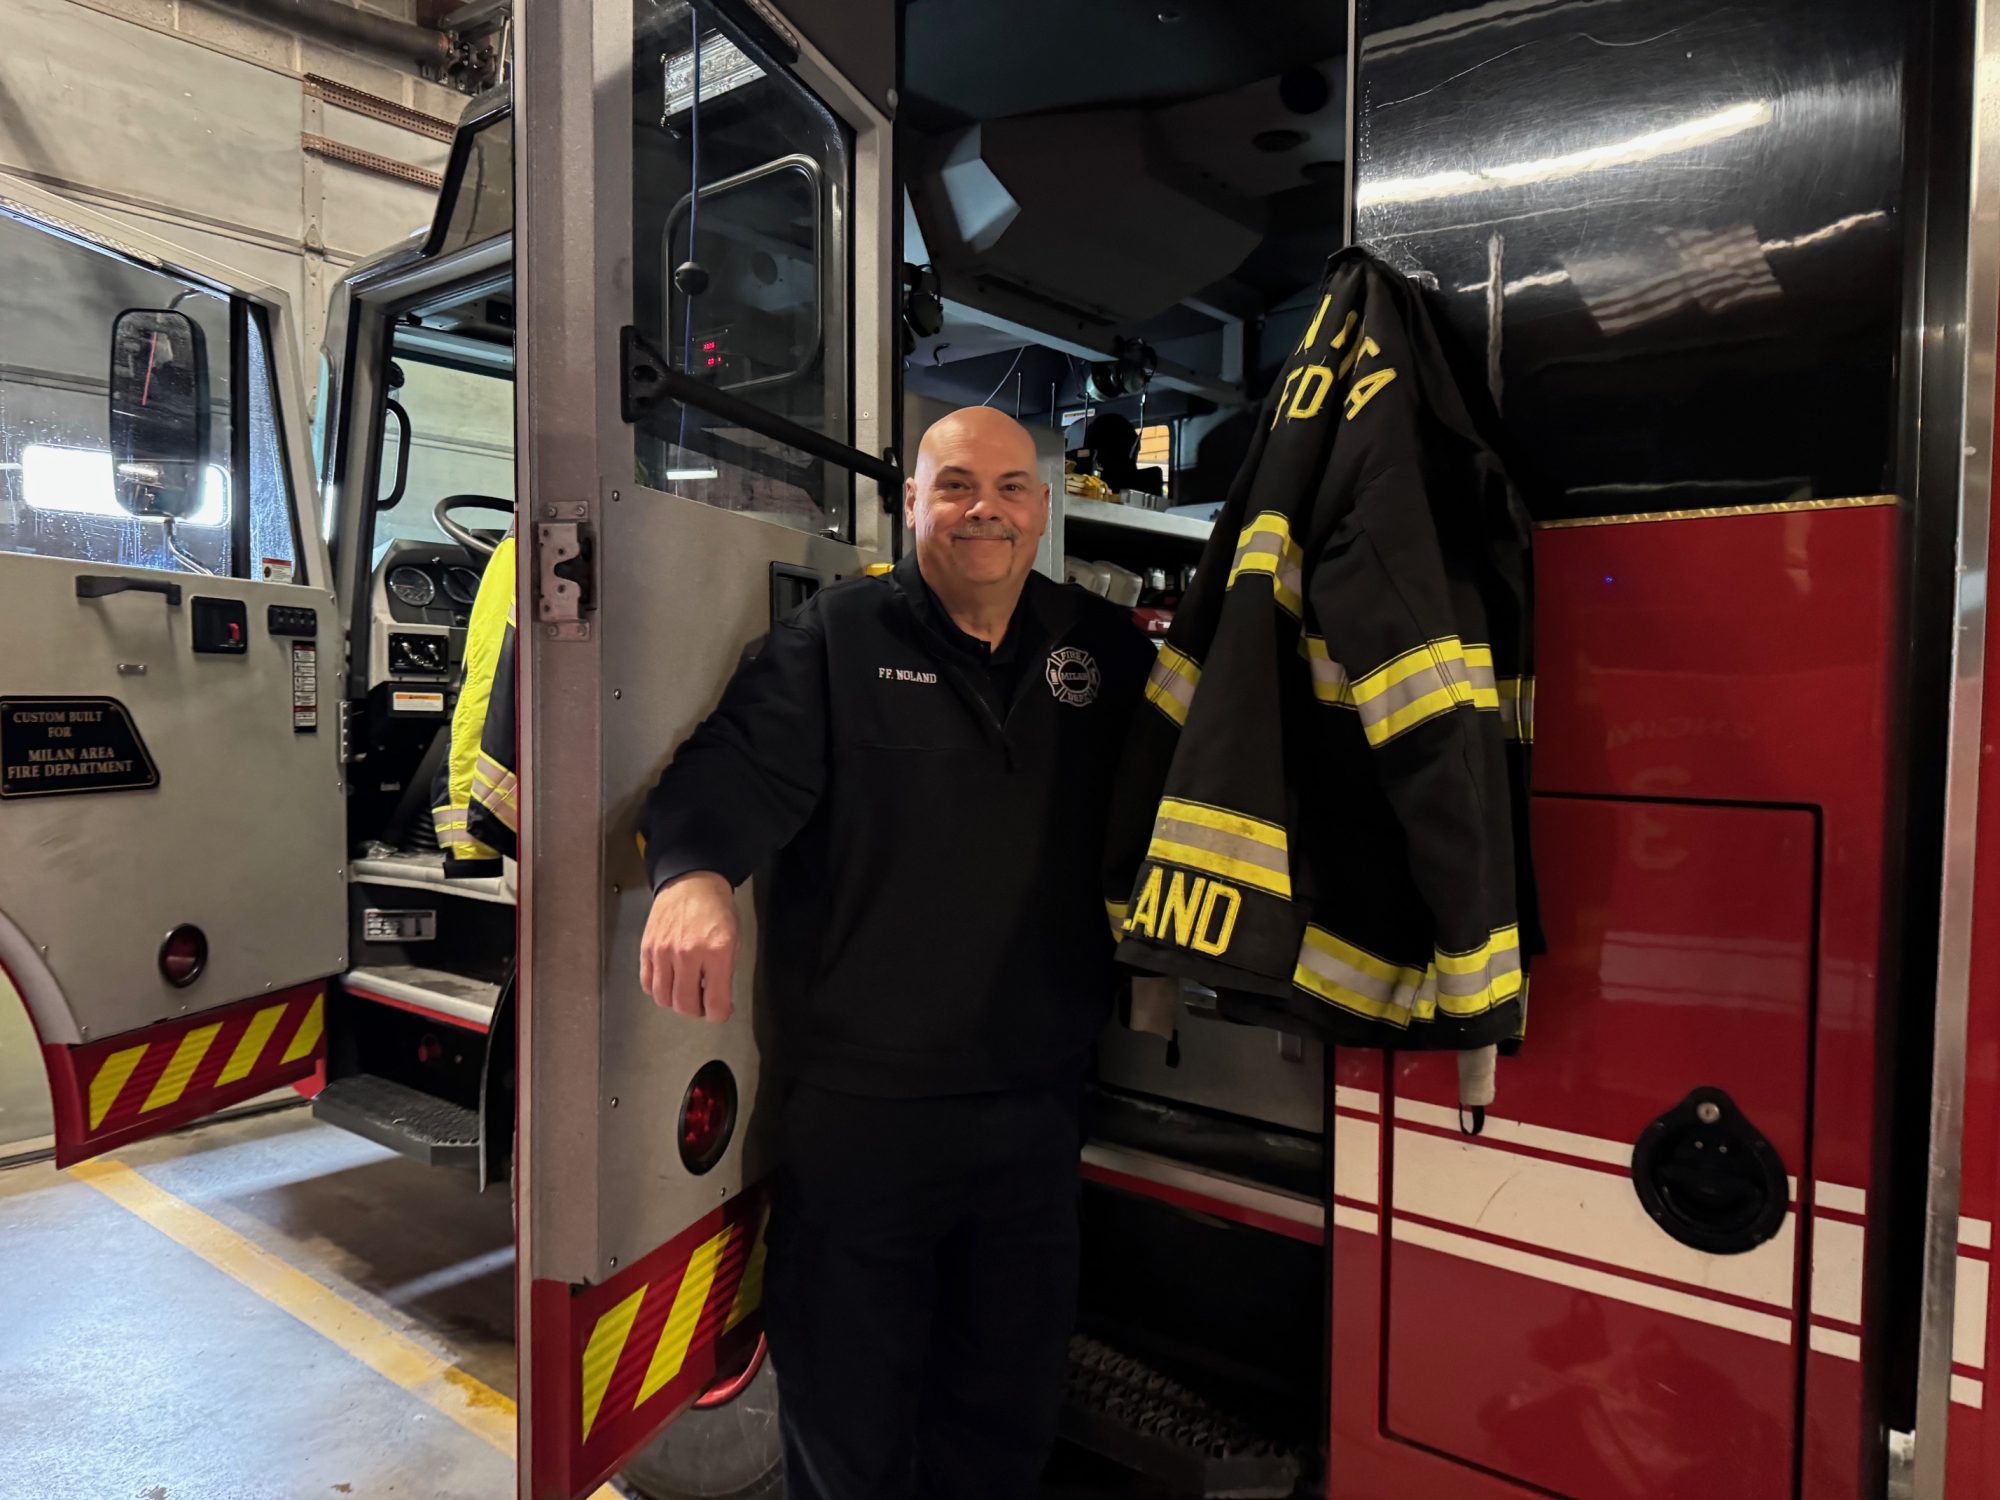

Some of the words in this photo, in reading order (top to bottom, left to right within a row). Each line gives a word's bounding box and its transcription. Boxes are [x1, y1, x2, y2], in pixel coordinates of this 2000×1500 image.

[1060, 650, 1082, 661] FIRE
[896, 669, 937, 684] NOLAND
[13, 711, 65, 723] CUSTOM
[69, 711, 103, 722] BUILT
[47, 726, 72, 738] FOR
[28, 748, 75, 762] MILAN
[79, 746, 115, 759] AREA
[8, 764, 40, 779] FIRE
[44, 760, 134, 777] DEPARTMENT
[1121, 866, 1242, 956] AND
